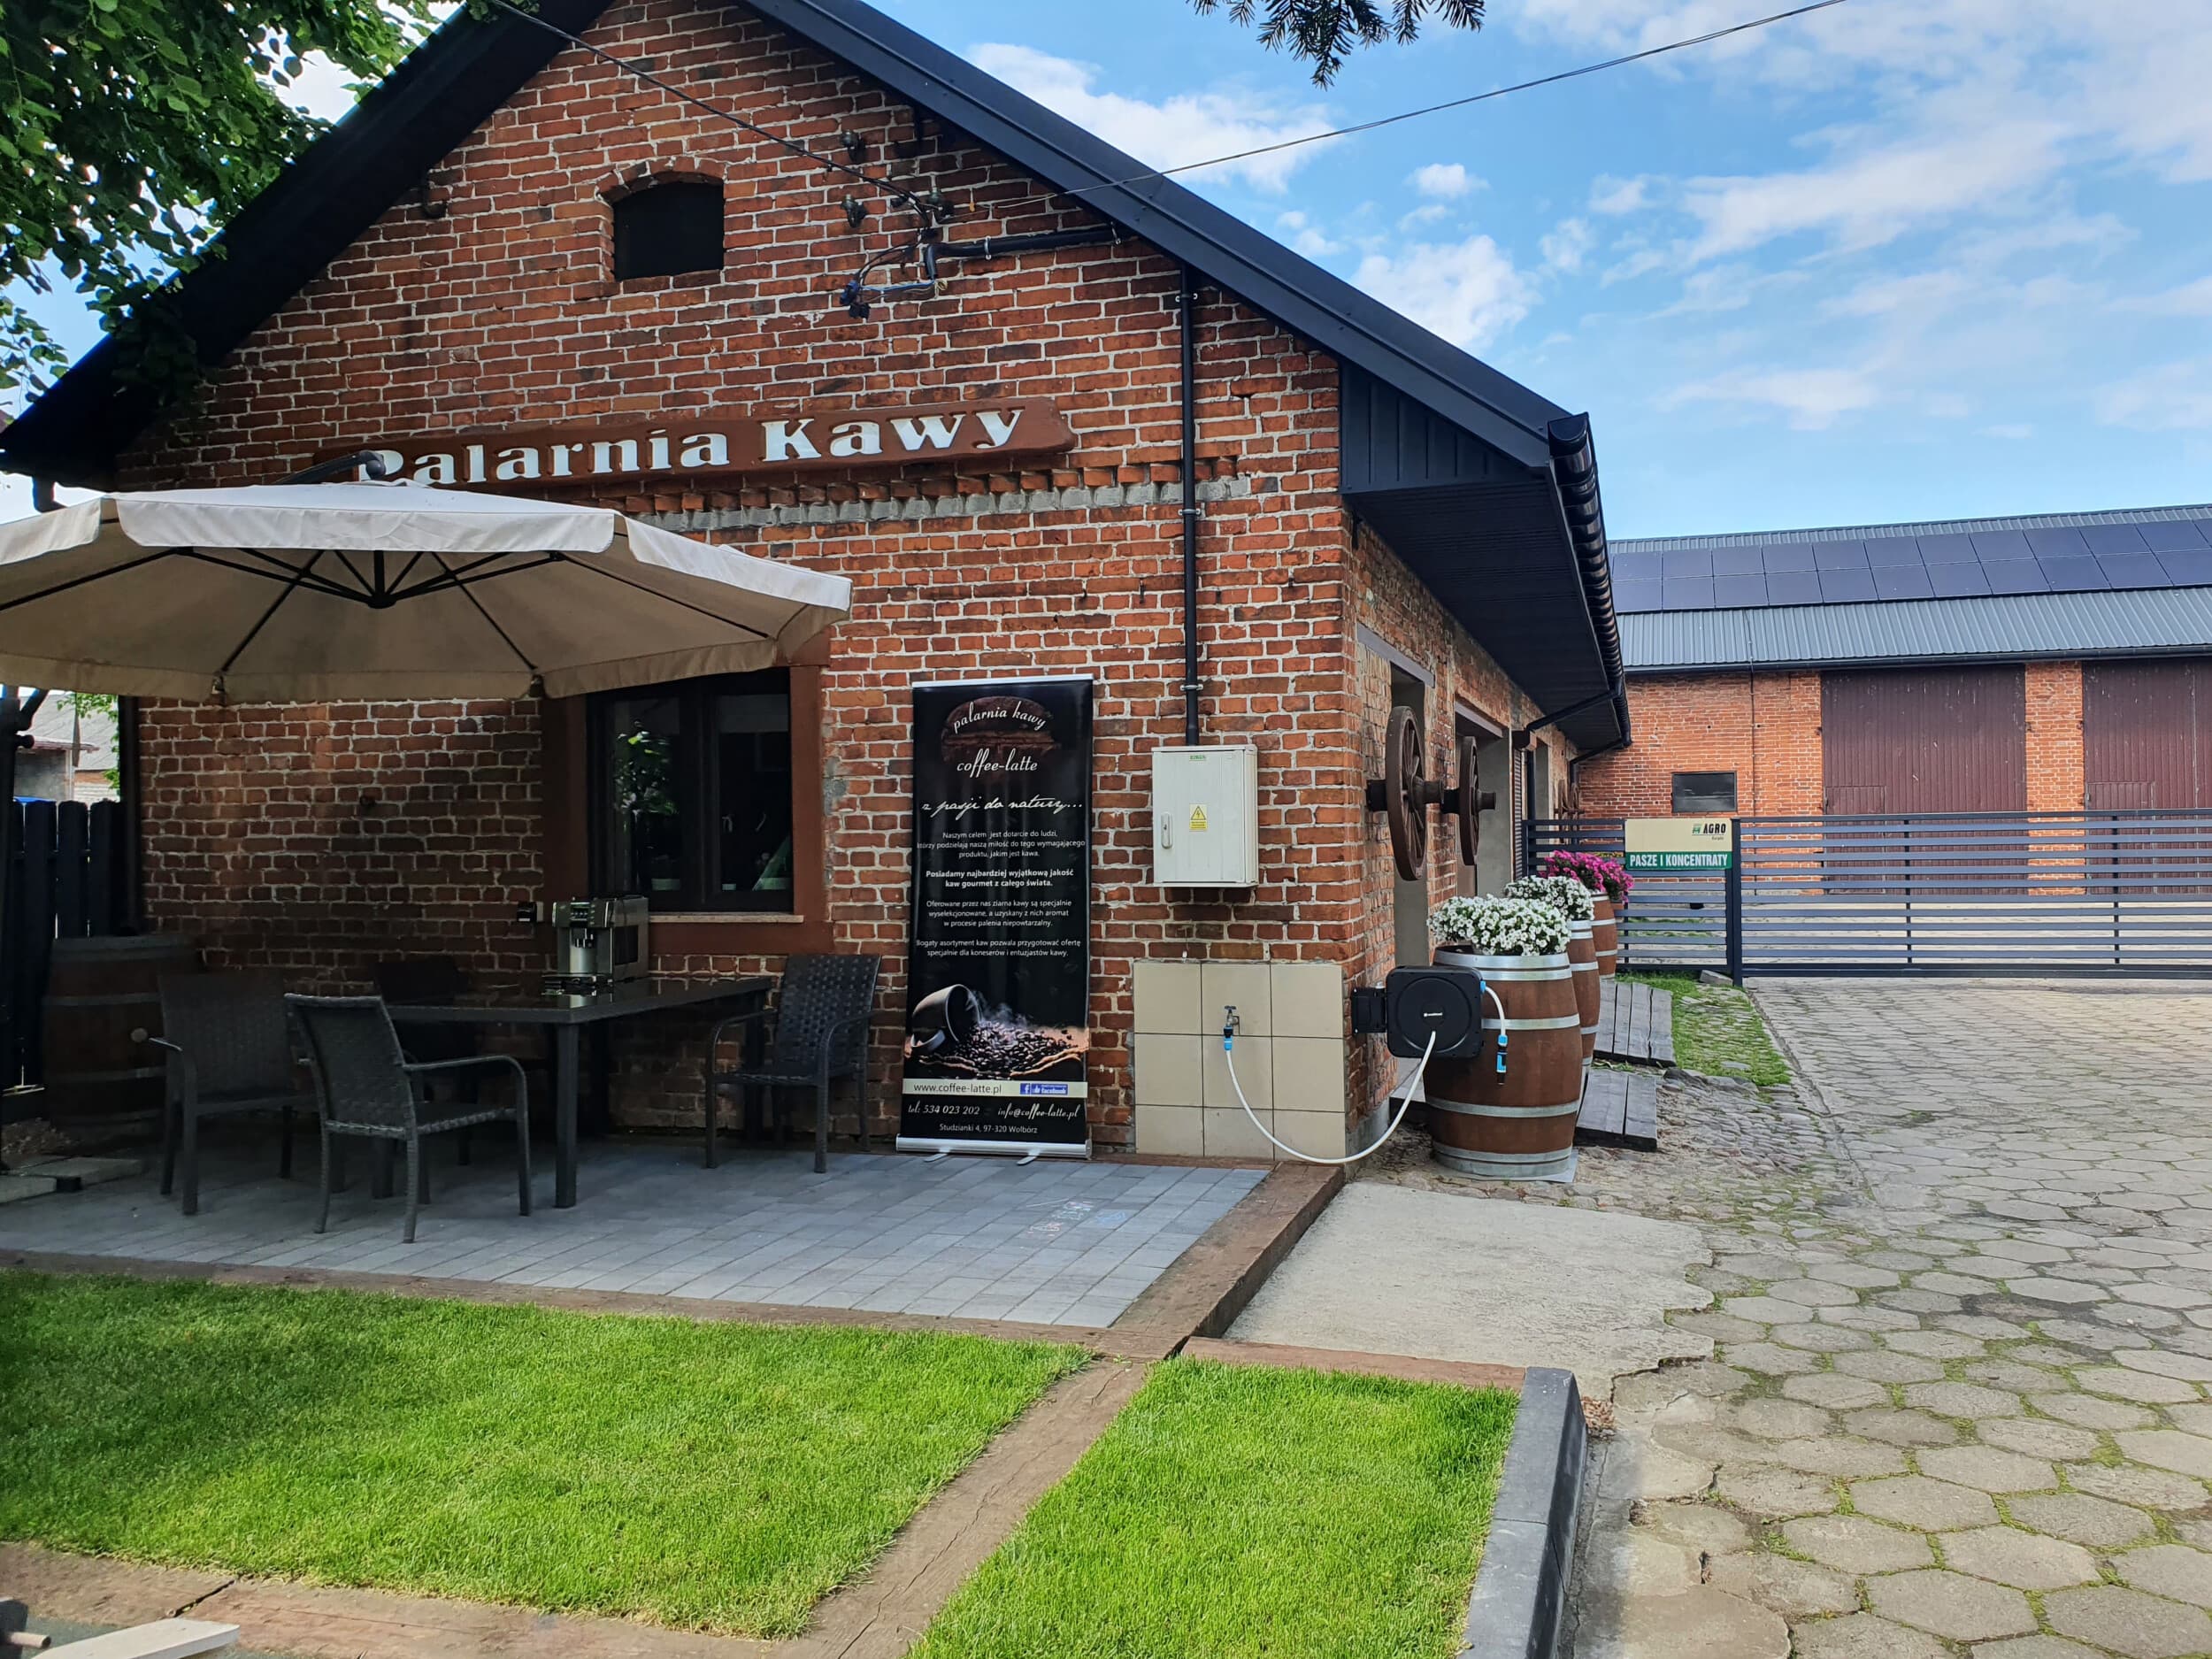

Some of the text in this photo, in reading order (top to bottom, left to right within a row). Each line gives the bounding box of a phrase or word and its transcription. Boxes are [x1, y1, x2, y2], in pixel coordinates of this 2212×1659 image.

[762, 410, 1024, 463] Kawy
[954, 701, 1047, 733] palarnia kawy
[956, 748, 1038, 778] coffee-latte
[983, 797, 1003, 810] do
[1703, 823, 1726, 833] AGRO
[989, 849, 1008, 858] jakim
[1009, 849, 1020, 858] jest
[1630, 854, 1728, 866] PASZE I KONCENTRATY
[926, 868, 1074, 879] Posiadamy najbardziej wyjątkową jakość
[962, 879, 993, 888] gourmet
[1013, 899, 1029, 908] kawy
[1040, 899, 1071, 908] specjalnie
[914, 1083, 1002, 1095] www.coffee-latte.pl
[923, 1104, 940, 1113] 534
[942, 1105, 961, 1114] 023
[962, 1106, 980, 1115] 202
[997, 1102, 1080, 1121] info@coffee-latte.pl
